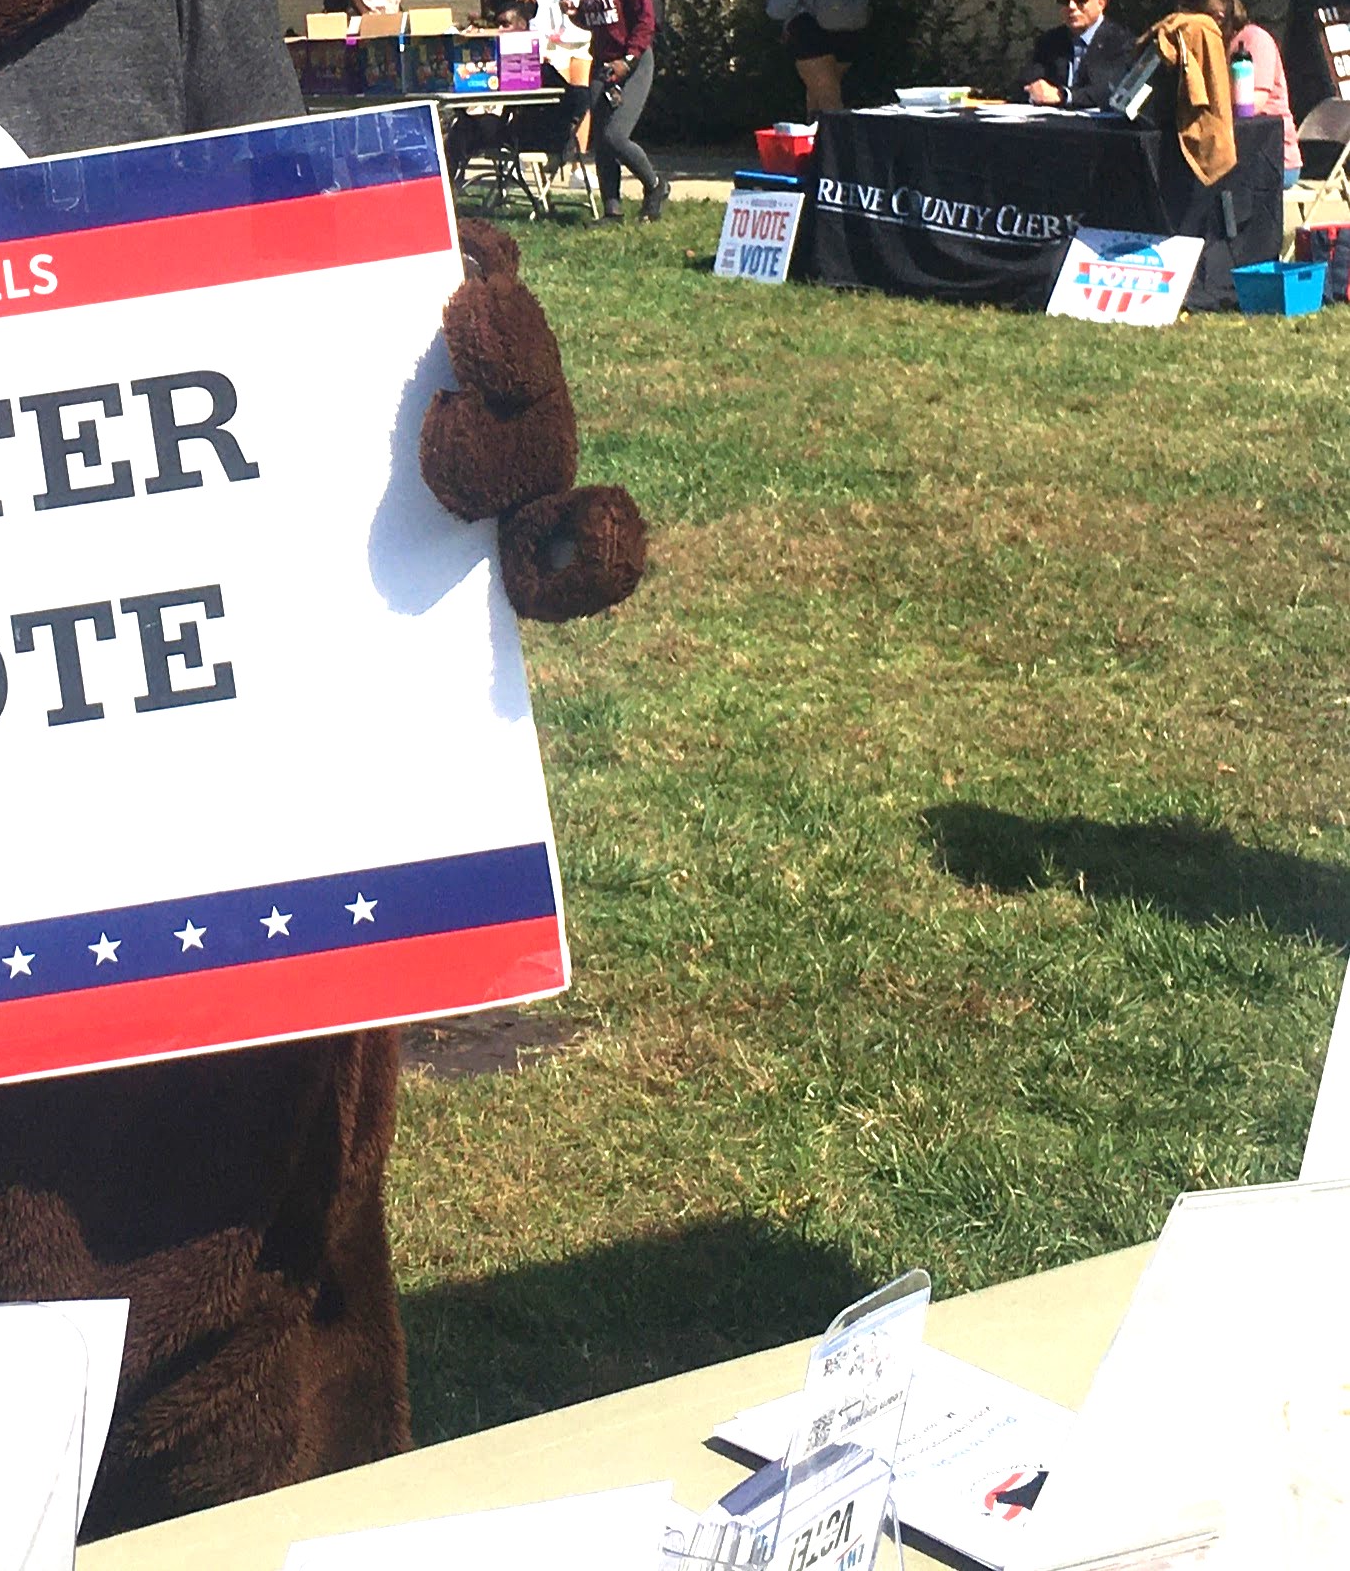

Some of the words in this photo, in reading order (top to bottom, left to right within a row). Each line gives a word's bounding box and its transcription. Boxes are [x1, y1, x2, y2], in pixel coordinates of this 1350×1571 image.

[730, 207, 751, 238] TO
[750, 210, 791, 242] VOTE
[891, 186, 991, 232] COUNTY
[739, 244, 783, 277] VOTE
